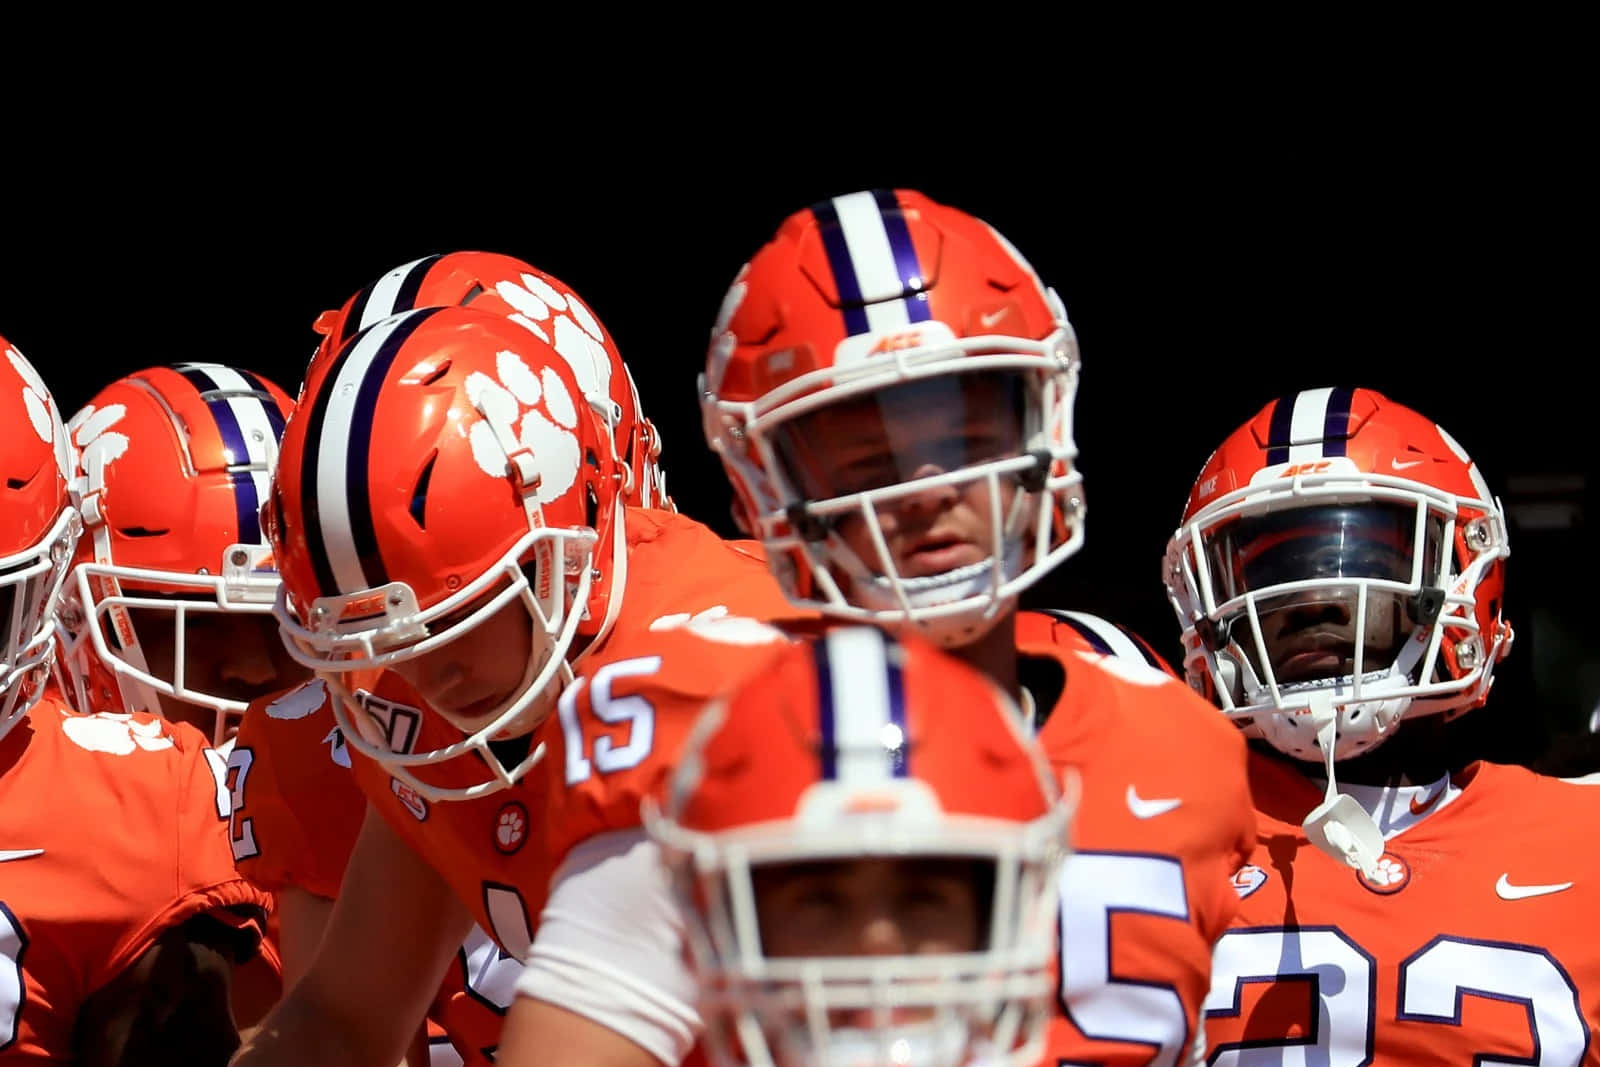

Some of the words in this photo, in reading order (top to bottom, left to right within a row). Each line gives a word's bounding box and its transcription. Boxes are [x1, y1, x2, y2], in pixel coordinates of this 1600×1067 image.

[1279, 461, 1331, 479] ACC
[352, 690, 422, 755] 50
[556, 655, 662, 787] 15
